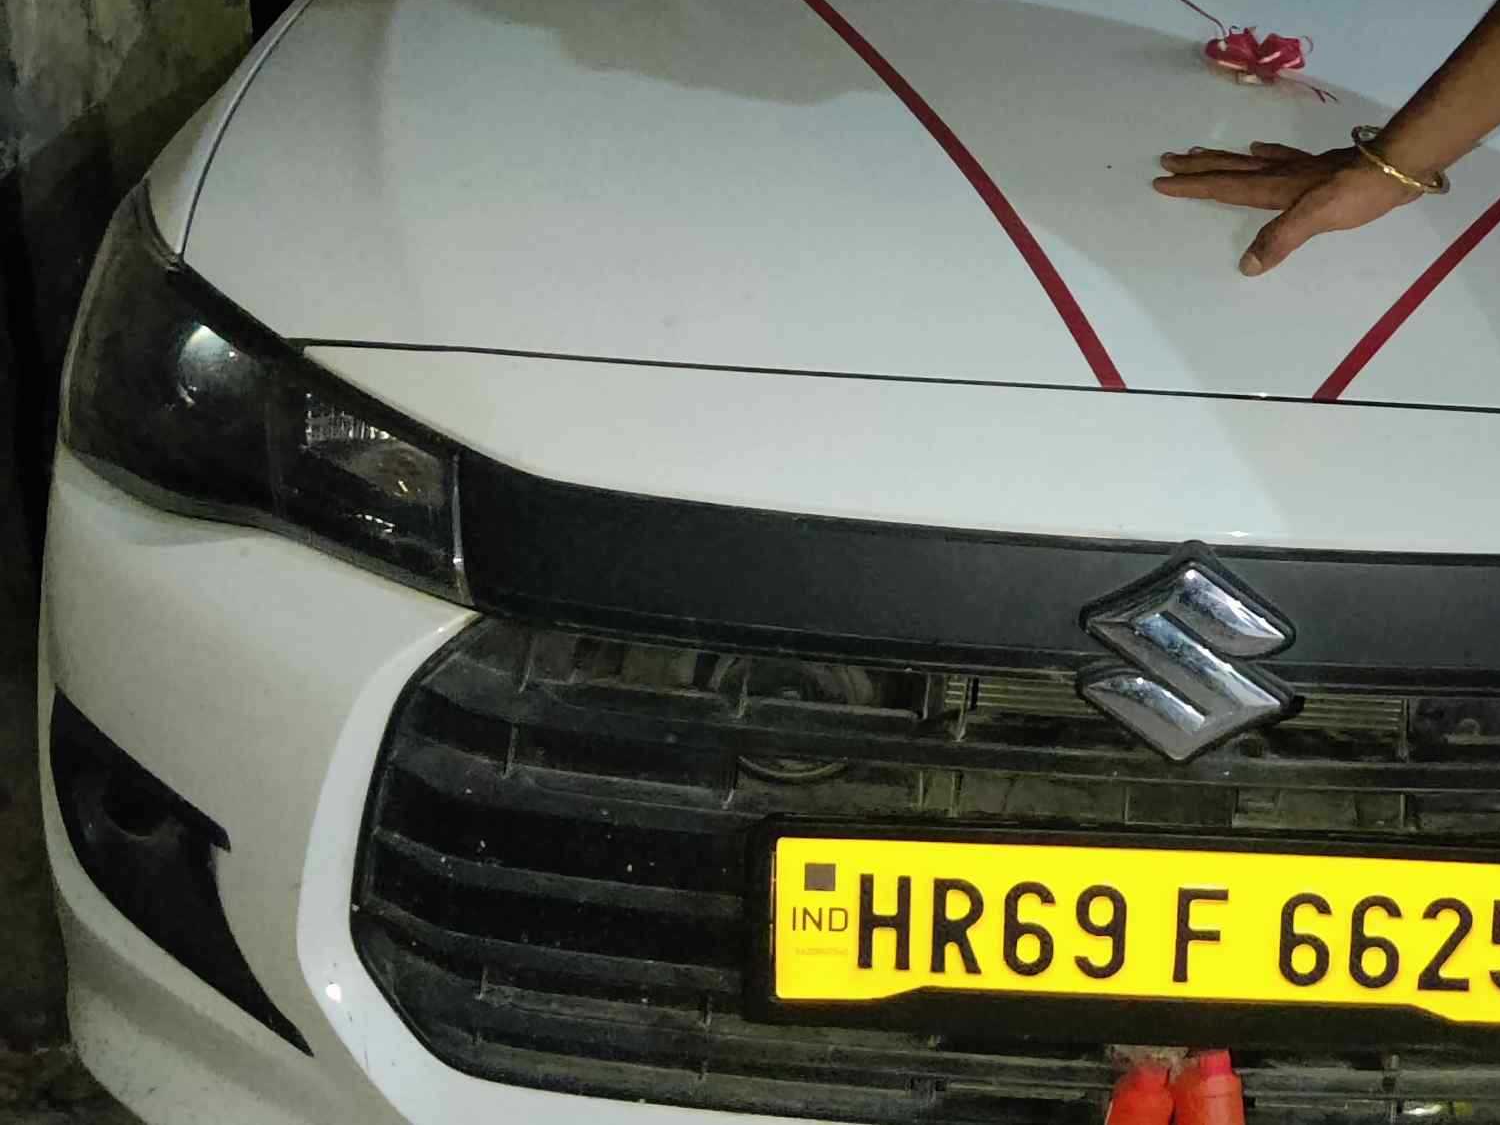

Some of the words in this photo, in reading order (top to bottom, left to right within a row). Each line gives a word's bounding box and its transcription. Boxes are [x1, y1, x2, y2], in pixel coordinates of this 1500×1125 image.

[792, 906, 848, 932] IND
[857, 873, 1127, 979] HR69
[1172, 888, 1229, 983] F
